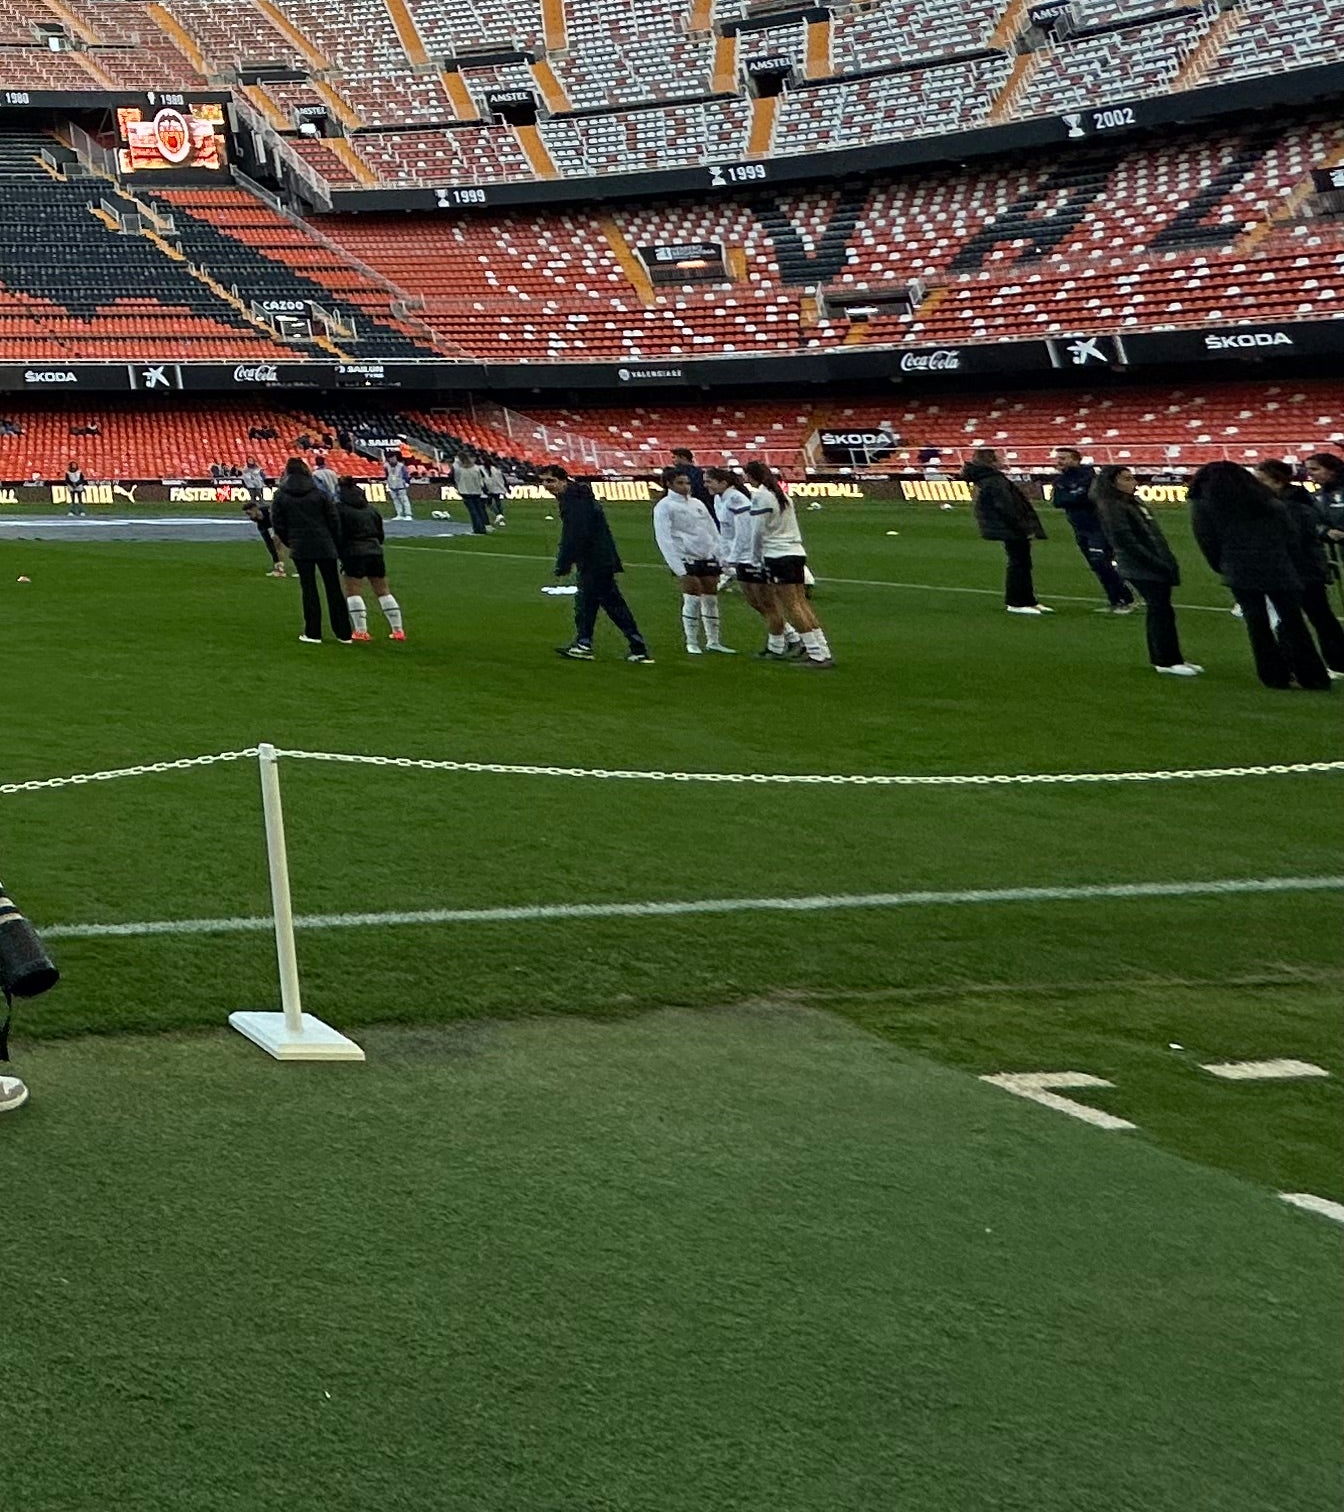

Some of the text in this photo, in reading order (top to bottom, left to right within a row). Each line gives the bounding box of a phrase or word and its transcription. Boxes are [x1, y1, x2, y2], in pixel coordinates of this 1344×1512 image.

[490, 92, 529, 103] AMSTEL
[1092, 107, 1137, 130] 2002
[727, 164, 767, 182] 1999
[452, 189, 486, 204] 1999
[262, 300, 305, 311] CAZOO
[1205, 332, 1294, 349] ŠKODA
[24, 370, 78, 382] ŠKODA
[822, 432, 892, 445] ŠKODA
[169, 487, 218, 502] FASTER
[590, 481, 651, 502] PUMA
[787, 482, 864, 498] FOOTBALL
[899, 480, 973, 502] PUMA
